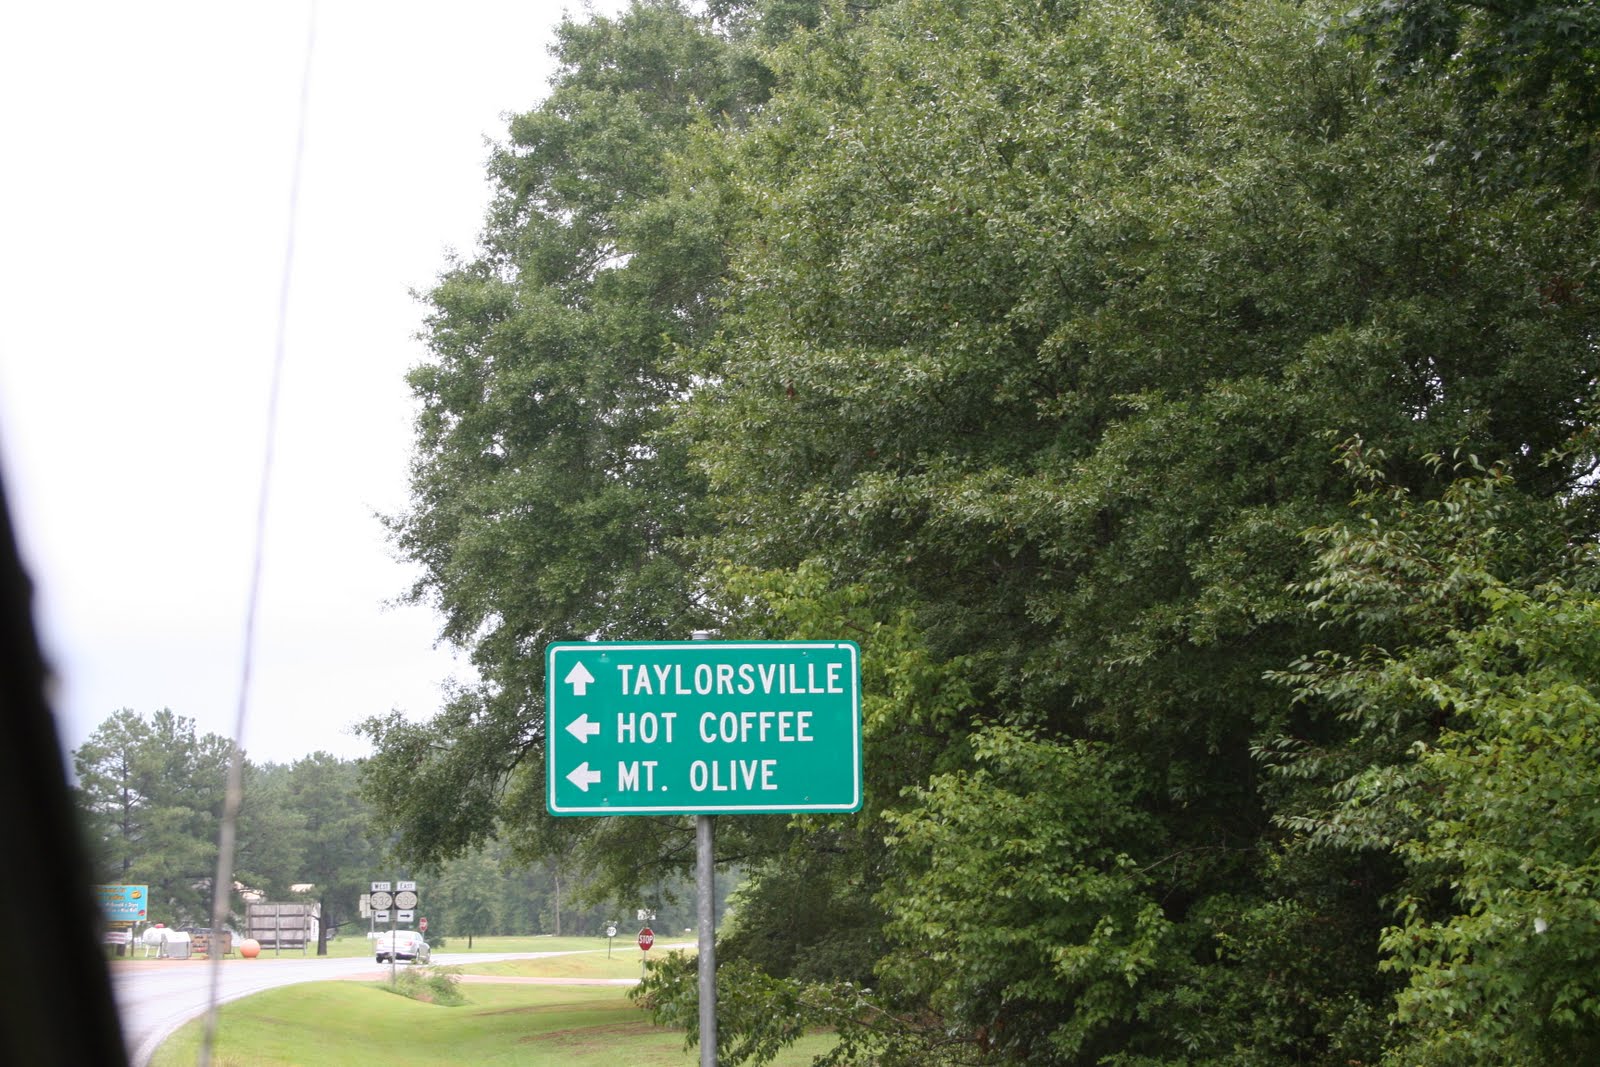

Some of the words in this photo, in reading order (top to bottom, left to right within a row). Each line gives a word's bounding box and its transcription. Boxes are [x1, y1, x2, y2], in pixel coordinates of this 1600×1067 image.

[617, 663, 843, 695] TAYLORSVILLE
[617, 712, 677, 743] HOT
[699, 711, 814, 743] COFFEE
[618, 760, 668, 792] MT.
[690, 759, 778, 792] OLIVE
[372, 896, 390, 906] 532
[397, 896, 414, 906] 532
[639, 935, 653, 944] STOP
